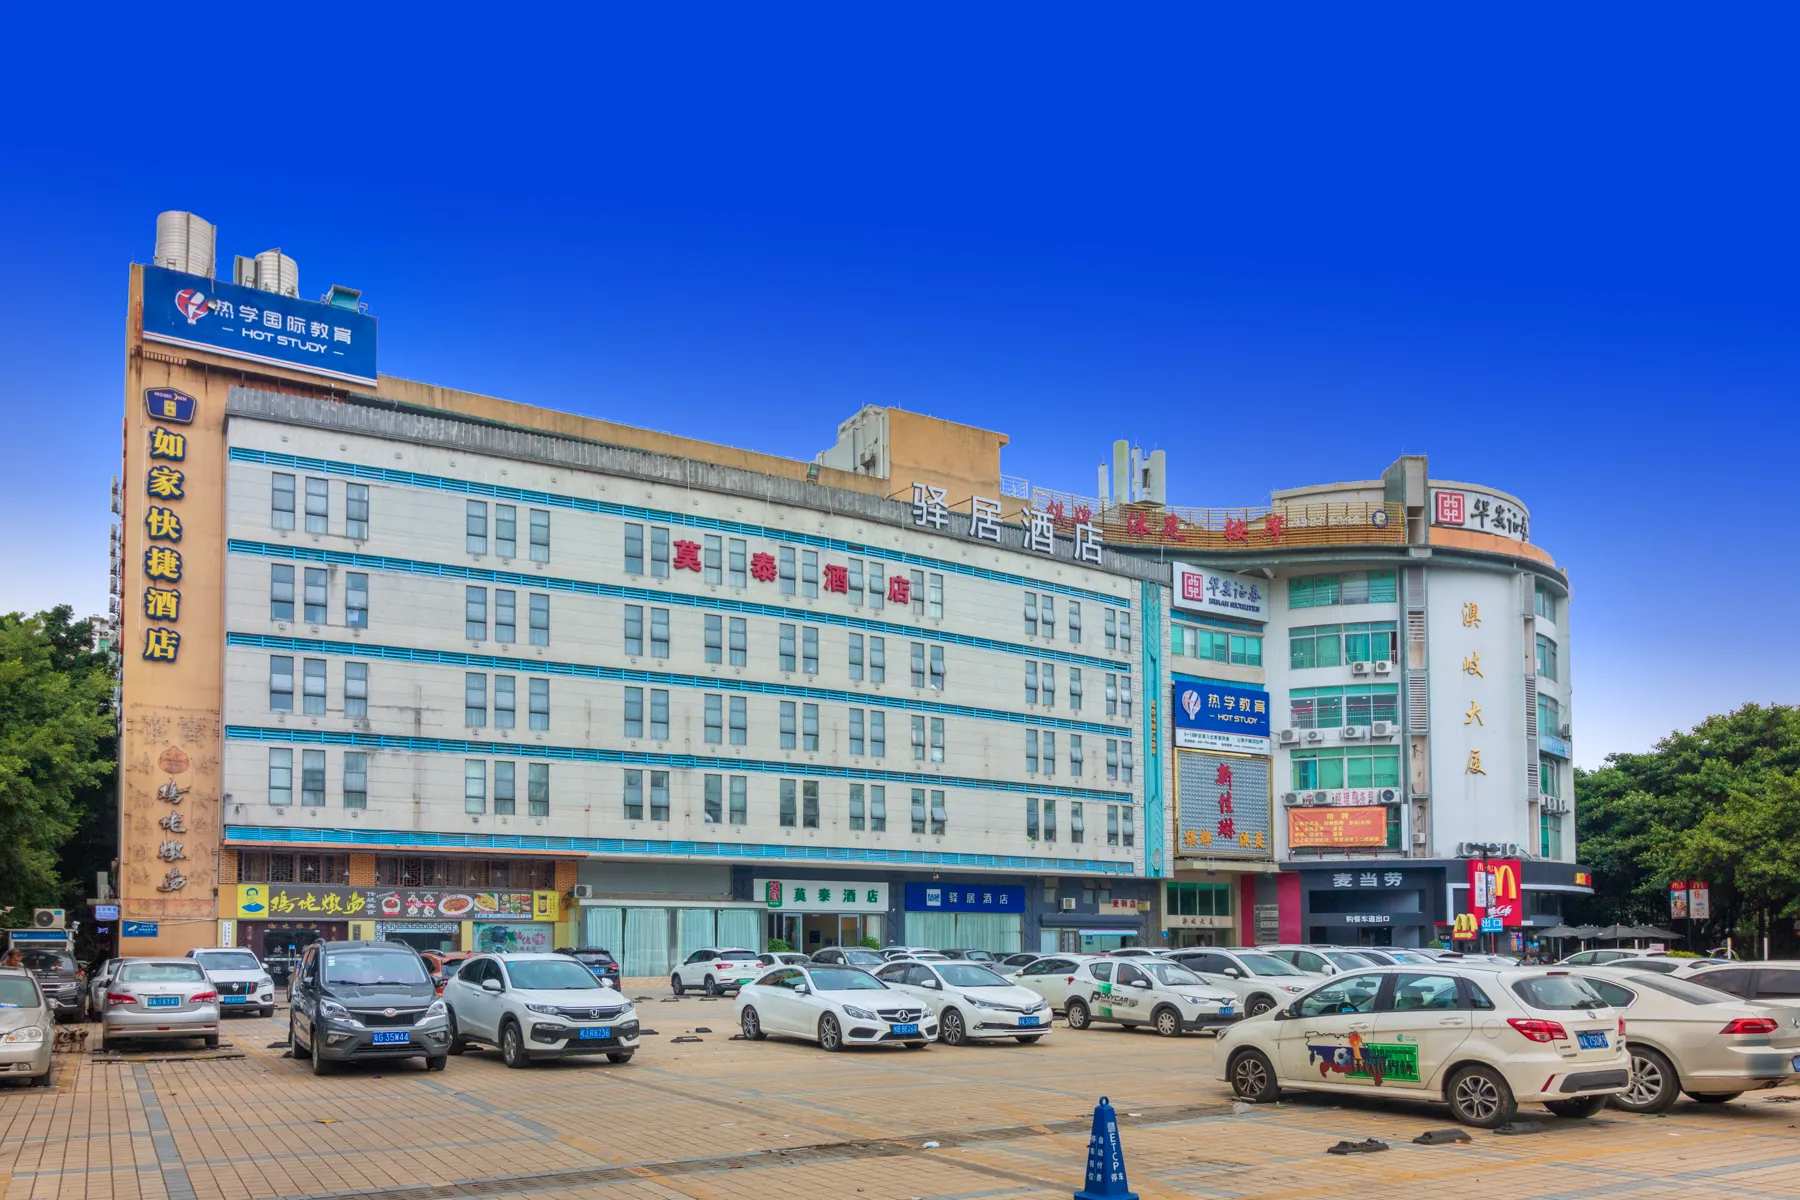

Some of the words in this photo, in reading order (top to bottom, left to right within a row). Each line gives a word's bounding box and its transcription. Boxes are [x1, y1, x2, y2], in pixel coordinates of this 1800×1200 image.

[212, 299, 352, 345] 热学国际教育
[242, 327, 275, 344] HOT
[277, 336, 328, 354] STUDY
[912, 482, 1104, 564] 驿居酒店
[1127, 511, 1186, 542] 沐足
[1224, 513, 1285, 542] 按摩
[1470, 498, 1529, 542] 华安证券
[144, 427, 186, 662] 如家快捷酒店
[673, 540, 911, 604] 莫泰酒店
[1206, 576, 1262, 602] 华安证券
[1208, 693, 1266, 714] 热学教育
[1217, 713, 1233, 722] HOT
[1234, 715, 1258, 725] STUDY
[1333, 872, 1403, 888] 麦当劳
[794, 887, 878, 904] 莫泰酒店
[948, 892, 1009, 905] 驿居酒店
[1345, 915, 1390, 923] 购餐车道出口
[1481, 918, 1502, 928] 出口
[1090, 990, 1129, 1005] PONYCAR
[1096, 1136, 1104, 1182] 自动付费
[1109, 1133, 1119, 1171] ETCP
[1111, 1172, 1124, 1183] 停车
